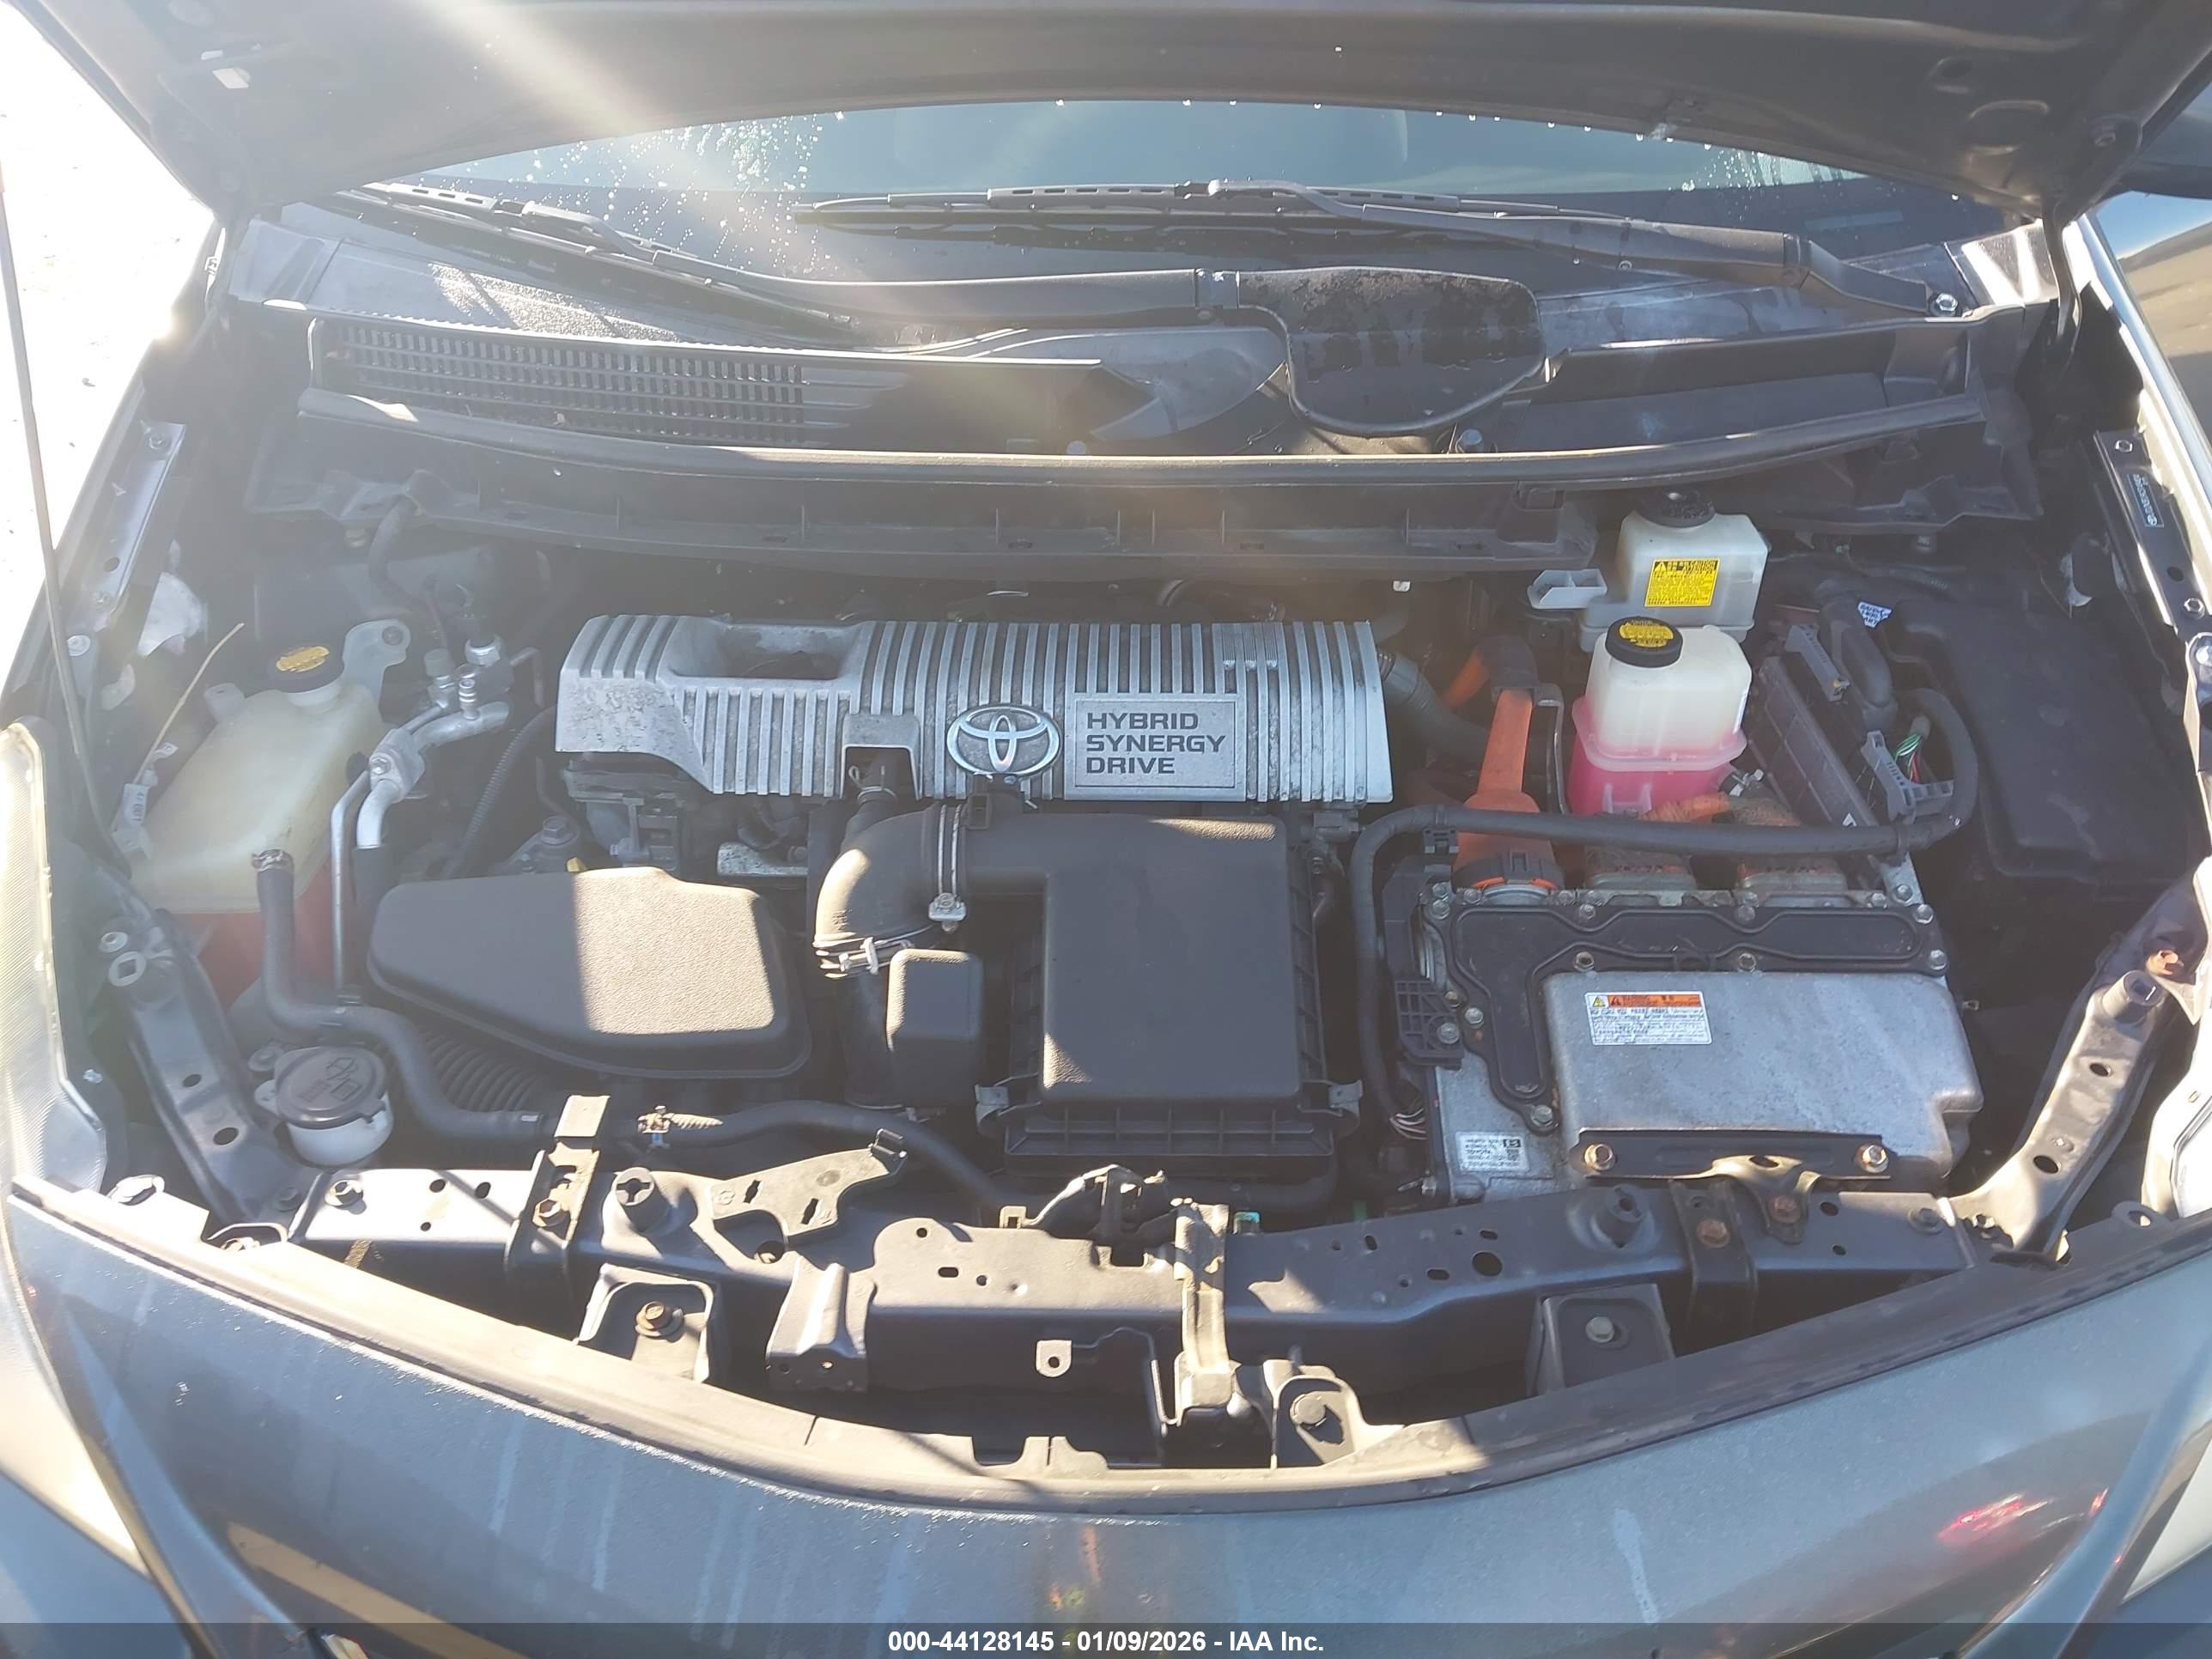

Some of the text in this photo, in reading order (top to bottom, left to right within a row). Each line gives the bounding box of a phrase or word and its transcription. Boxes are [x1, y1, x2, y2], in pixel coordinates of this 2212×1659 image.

[1087, 713, 1198, 729] HYBRID
[1086, 735, 1225, 751] SYNERGY
[1086, 757, 1175, 774] DRIVE
